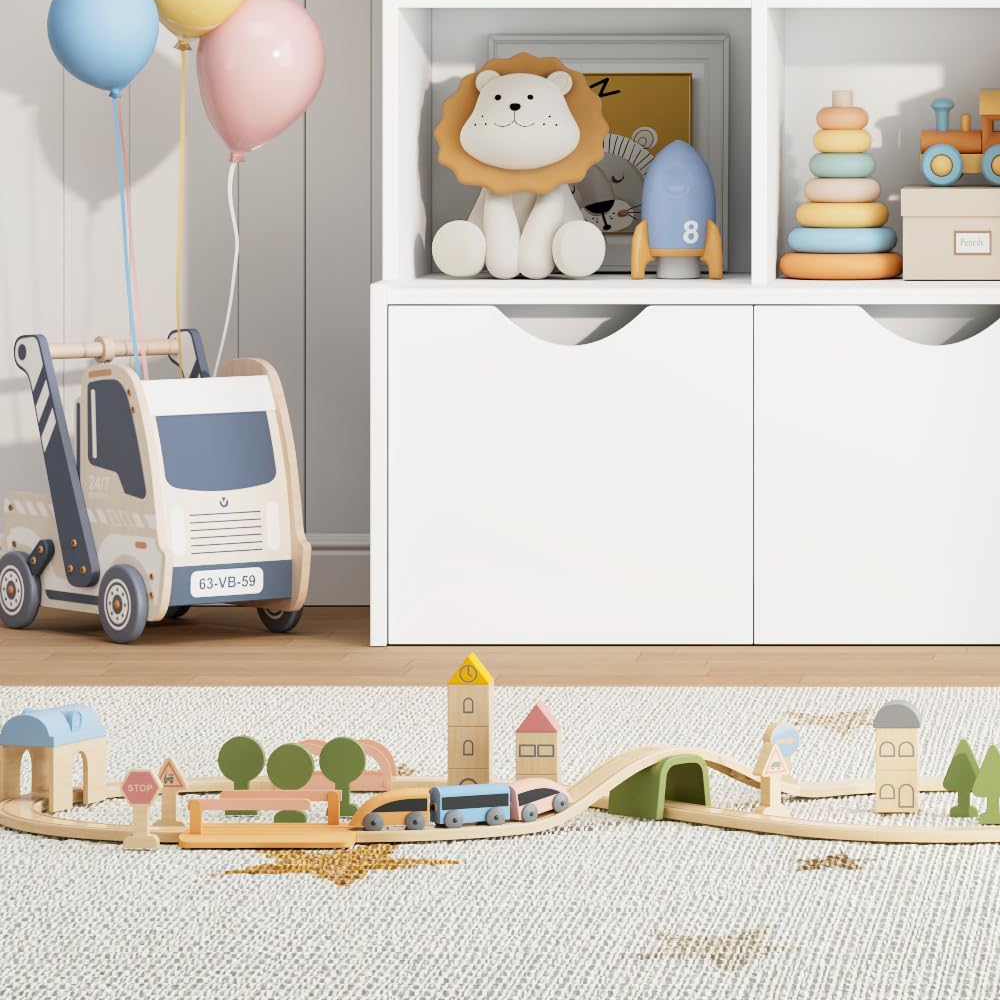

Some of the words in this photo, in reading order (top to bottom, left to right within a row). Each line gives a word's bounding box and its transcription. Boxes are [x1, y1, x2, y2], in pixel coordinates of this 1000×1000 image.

[683, 220, 699, 244] 8
[199, 574, 256, 590] 63-VB-59
[127, 784, 153, 792] STOP
